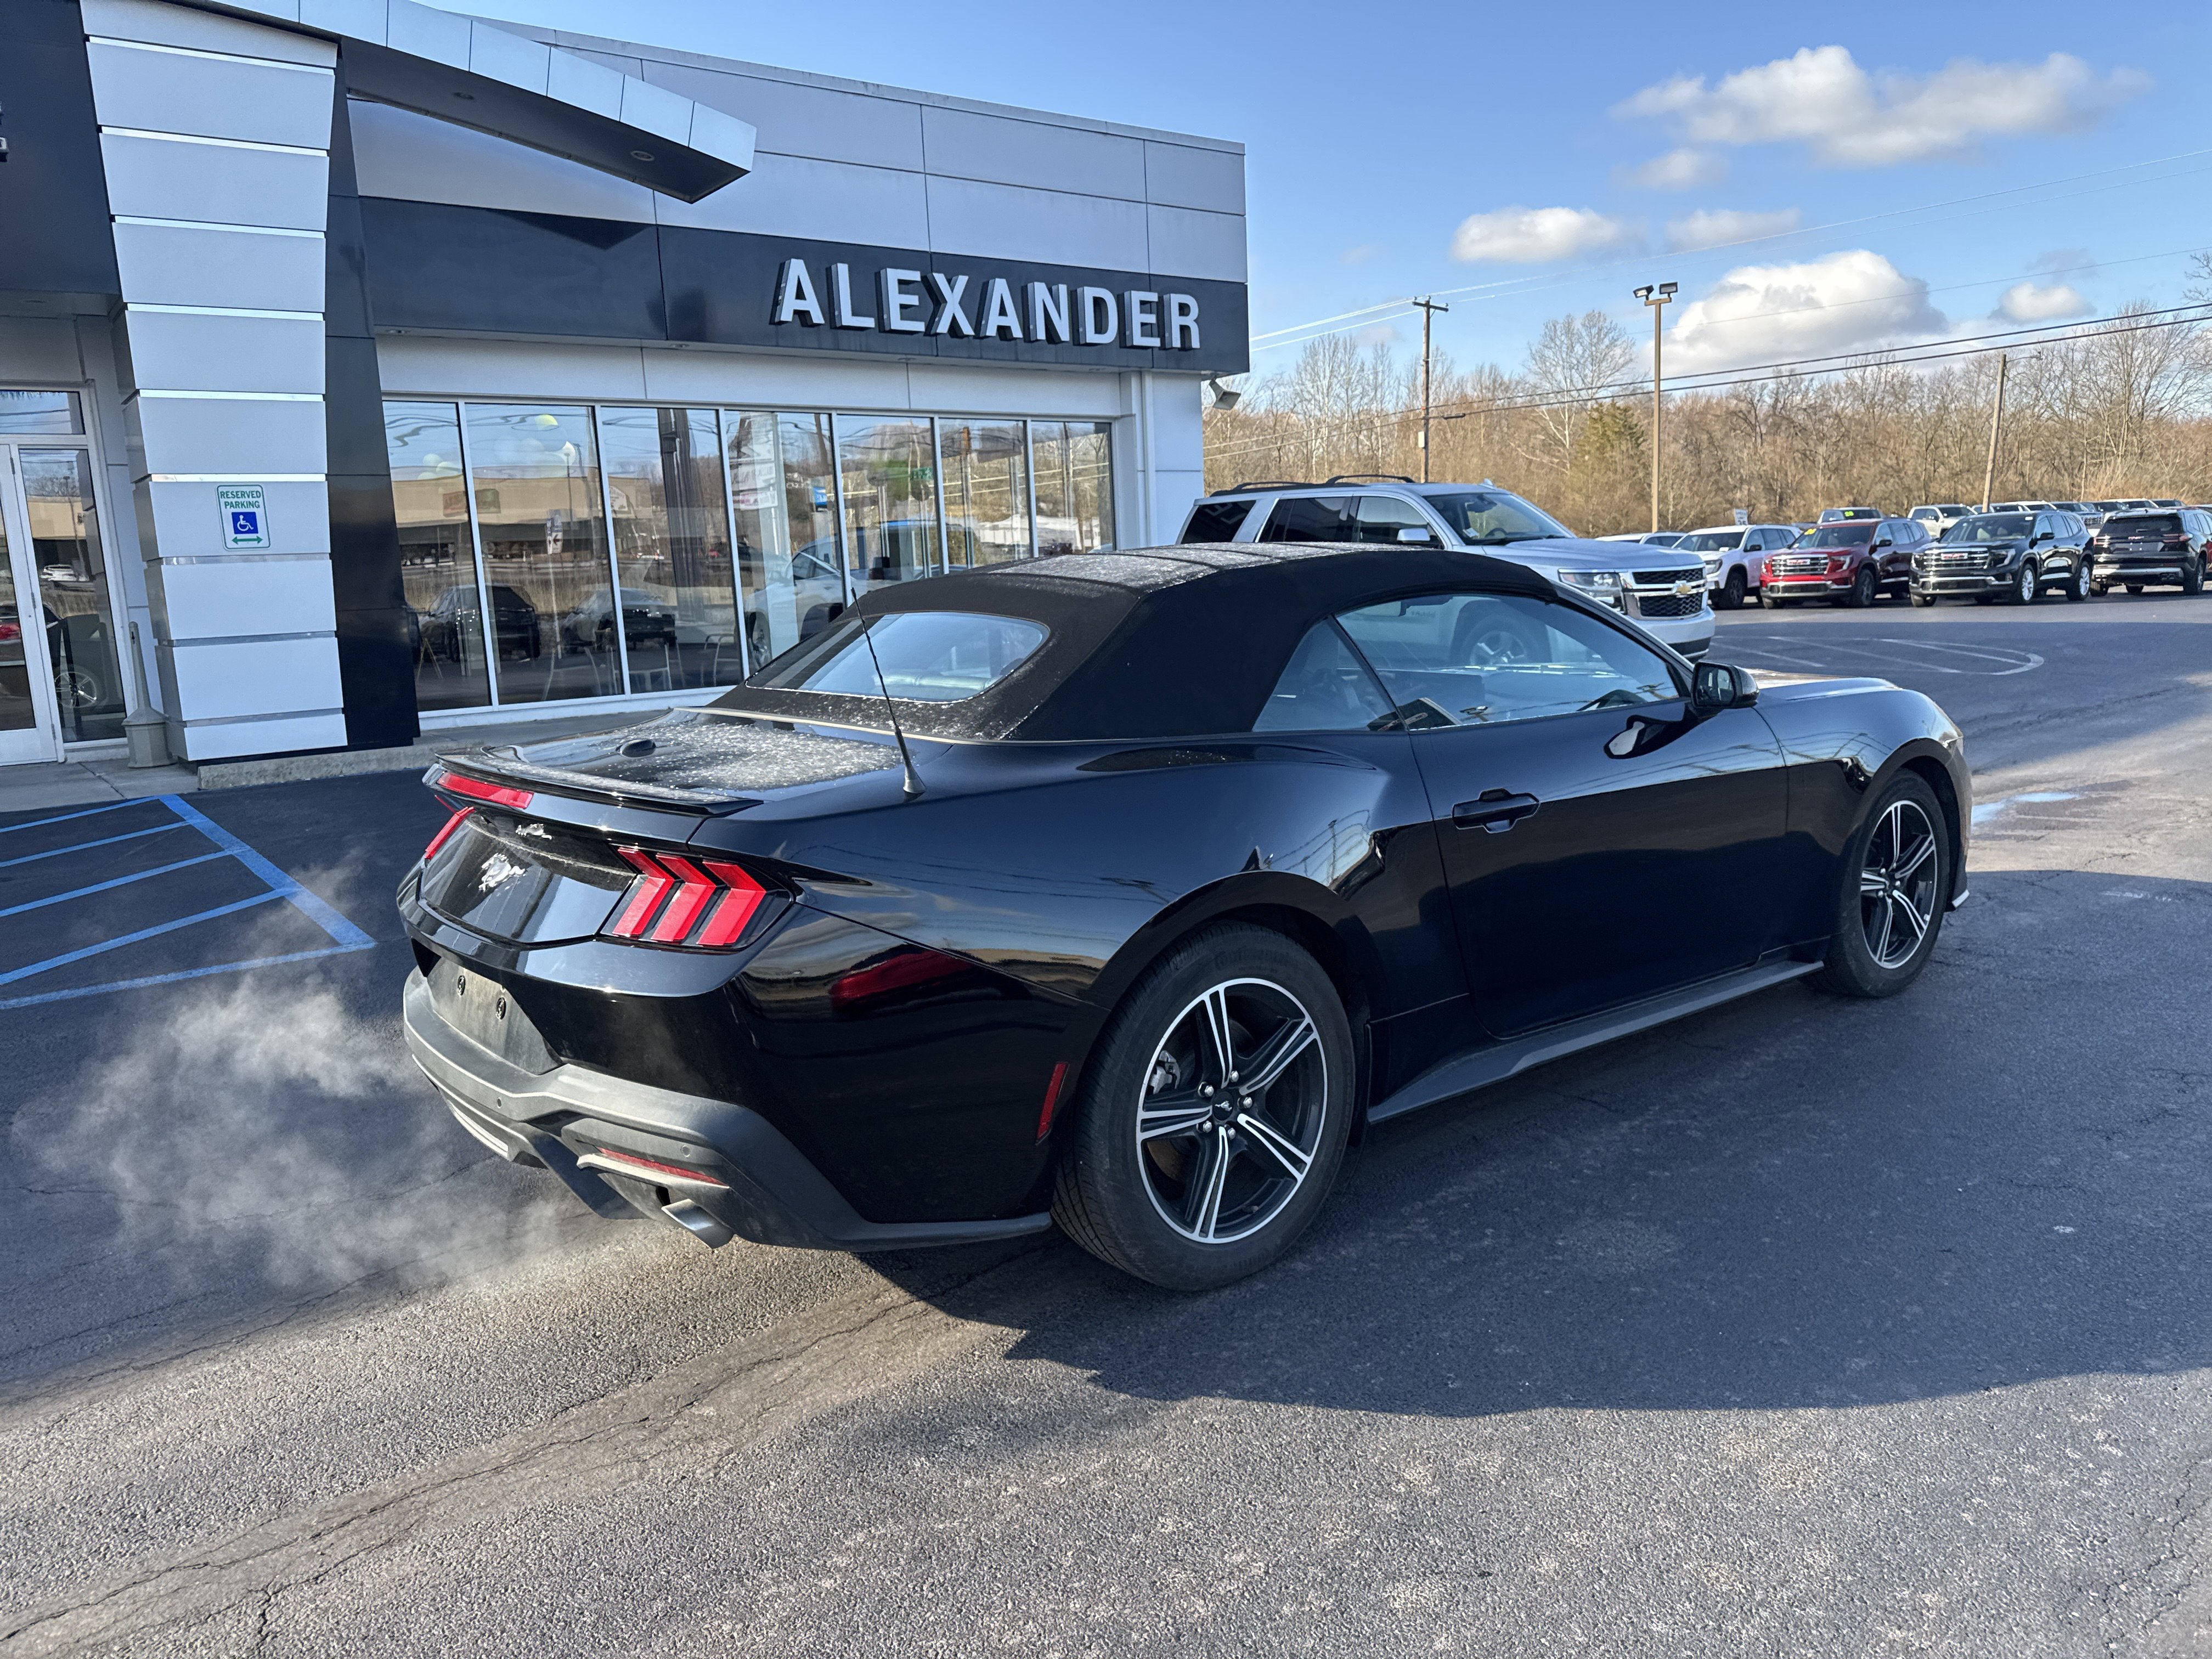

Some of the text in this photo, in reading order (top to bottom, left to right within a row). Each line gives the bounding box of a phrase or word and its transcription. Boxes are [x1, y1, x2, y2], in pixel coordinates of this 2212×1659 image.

[776, 258, 1200, 349] ALEXANDER
[219, 490, 261, 499] RESERVED
[224, 500, 260, 509] PARKING
